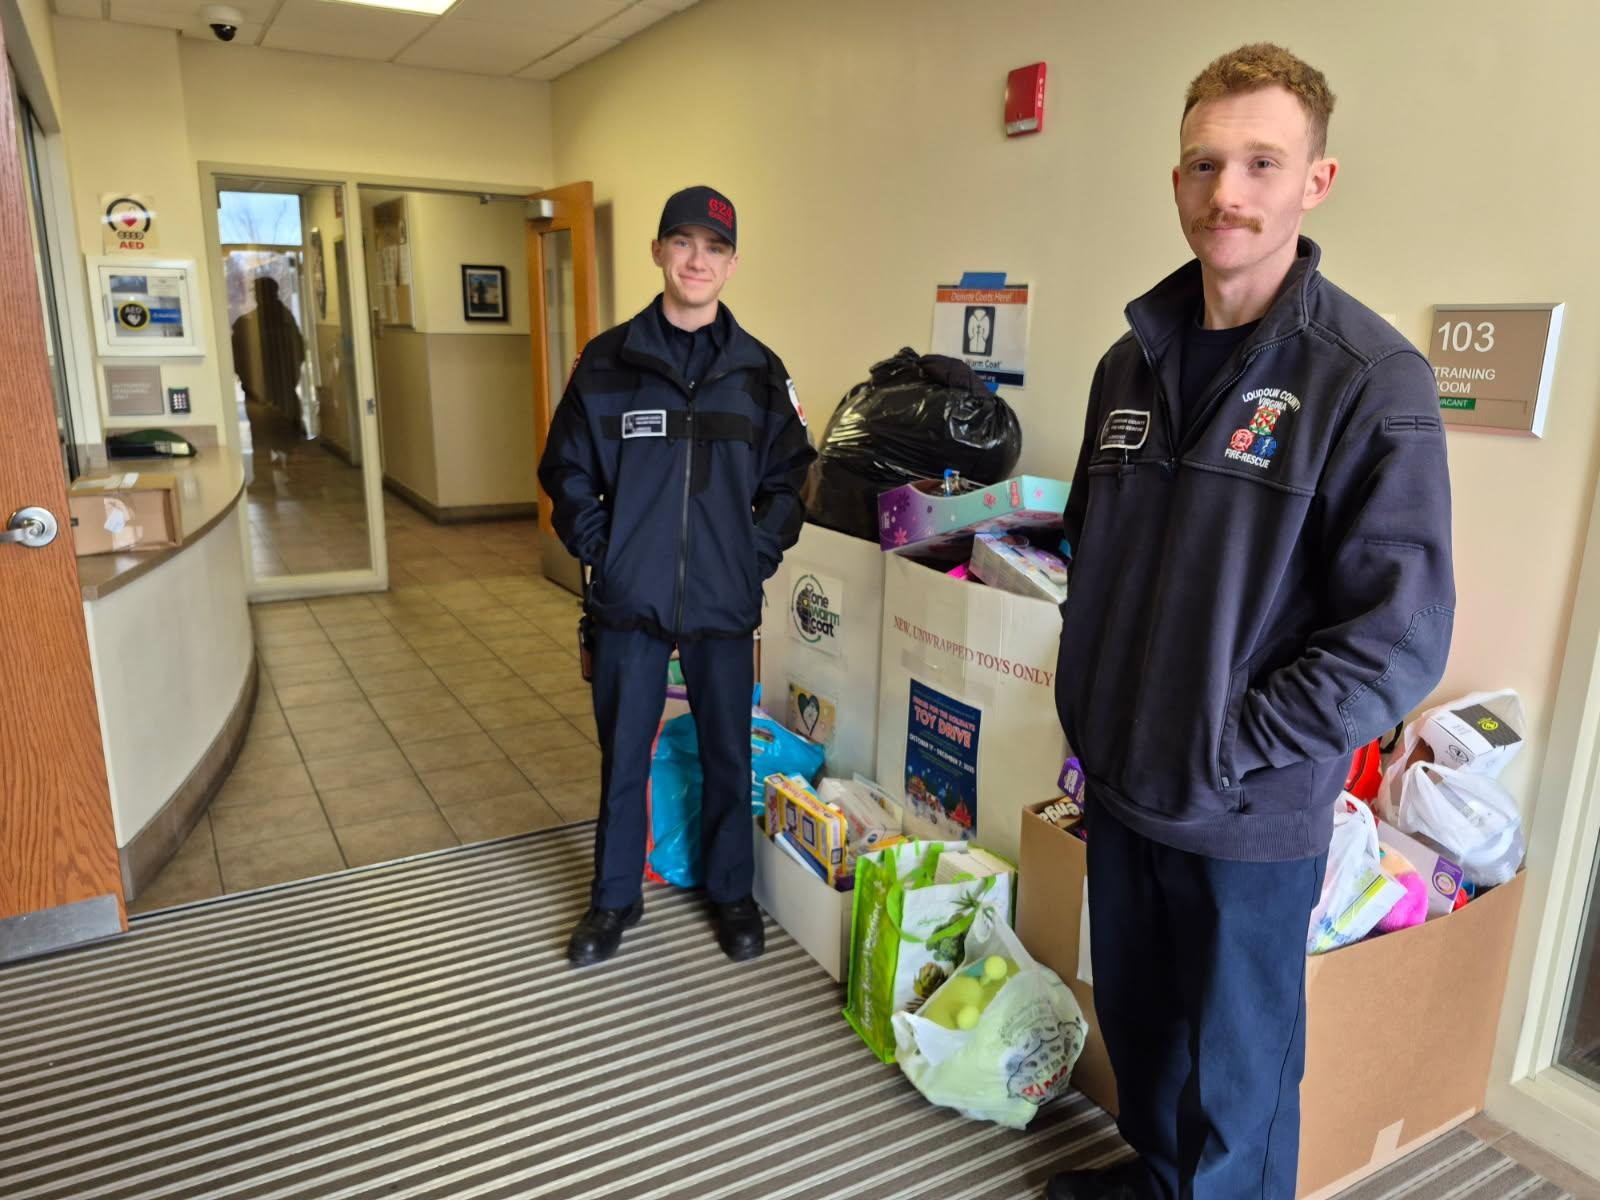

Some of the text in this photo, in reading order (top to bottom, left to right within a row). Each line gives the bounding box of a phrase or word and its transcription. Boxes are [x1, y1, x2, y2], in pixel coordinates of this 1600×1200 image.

[119, 241, 145, 250] AED
[1438, 321, 1495, 352] 103
[1432, 366, 1496, 381] TRAINING
[1436, 381, 1471, 393] OOM
[1242, 388, 1301, 412] LOUDOUN COUNTY
[1258, 397, 1287, 411] VIRGINIA
[1224, 448, 1271, 469] FIRE-RESCUE
[811, 593, 829, 609] one
[809, 605, 840, 626] warm
[811, 618, 834, 638] coat
[894, 615, 1054, 687] NEW, UNWRAPPED TOYS ONLY
[914, 705, 972, 749] TOY DRIVE
